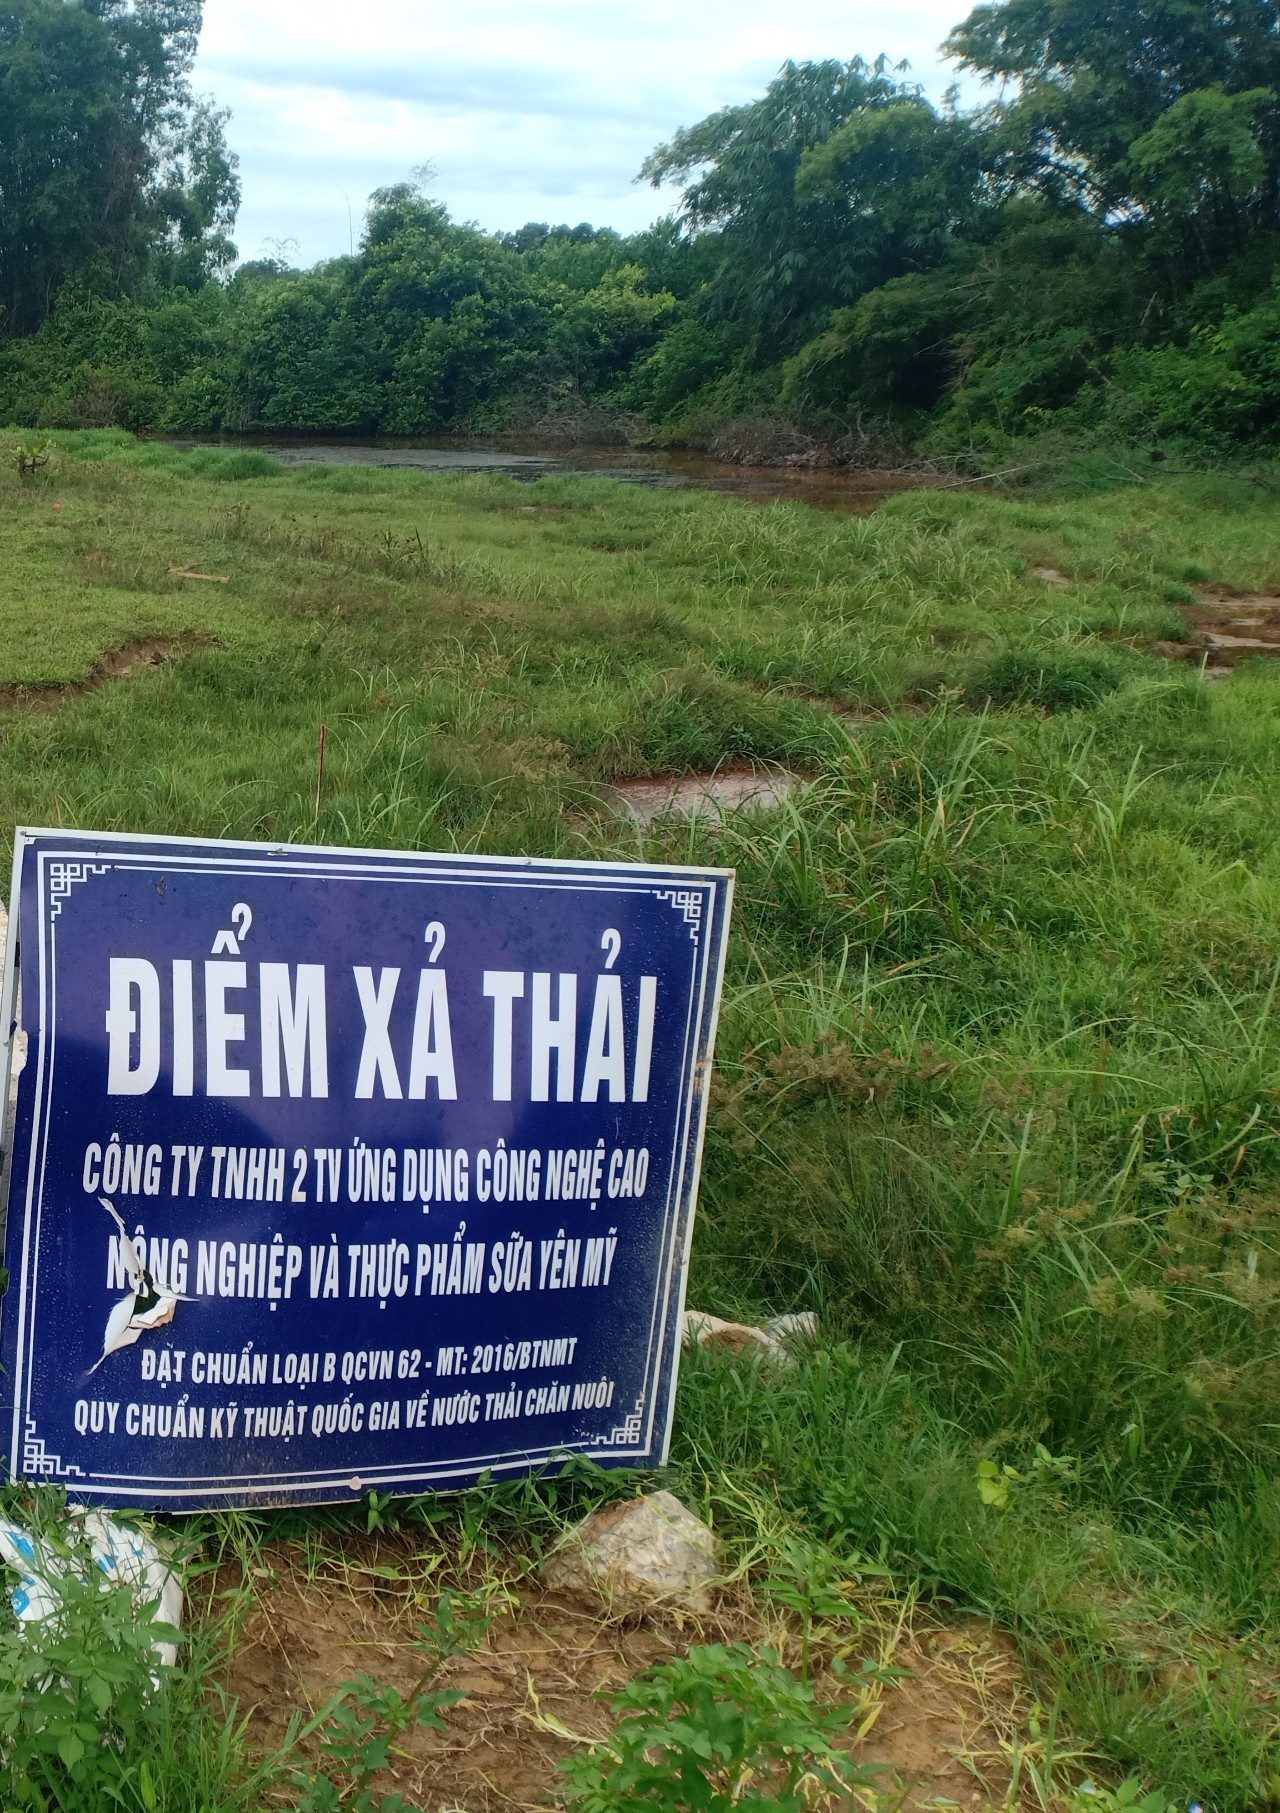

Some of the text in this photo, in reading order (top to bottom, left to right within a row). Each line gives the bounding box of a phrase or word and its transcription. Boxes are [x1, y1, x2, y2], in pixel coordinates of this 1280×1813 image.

[106, 902, 657, 1102] ĐIỂM XẢ THẢI
[82, 1132, 650, 1214] CÔNG TY TNHH 2 TV ỨNG DỤNG CÔNG NGHỆ CAO
[106, 1220, 618, 1311] NÔNG NGHIỆP VÀ THỰC PHẨM SỮA YÊN MỸ
[141, 1349, 186, 1389] ĐẠT
[192, 1341, 268, 1385] CHUẨN
[272, 1352, 319, 1390] LOẠI
[323, 1352, 337, 1383] B
[341, 1350, 394, 1385] QCVN
[397, 1349, 422, 1379] 62
[436, 1347, 469, 1377] MT:
[470, 1337, 578, 1374] 2016/BTNMT
[74, 1376, 615, 1443] QUY CHUẨN KỸ THUẬT QUỐC GIA VỀ NƯỚC THẢI CHĂN NUÔI
